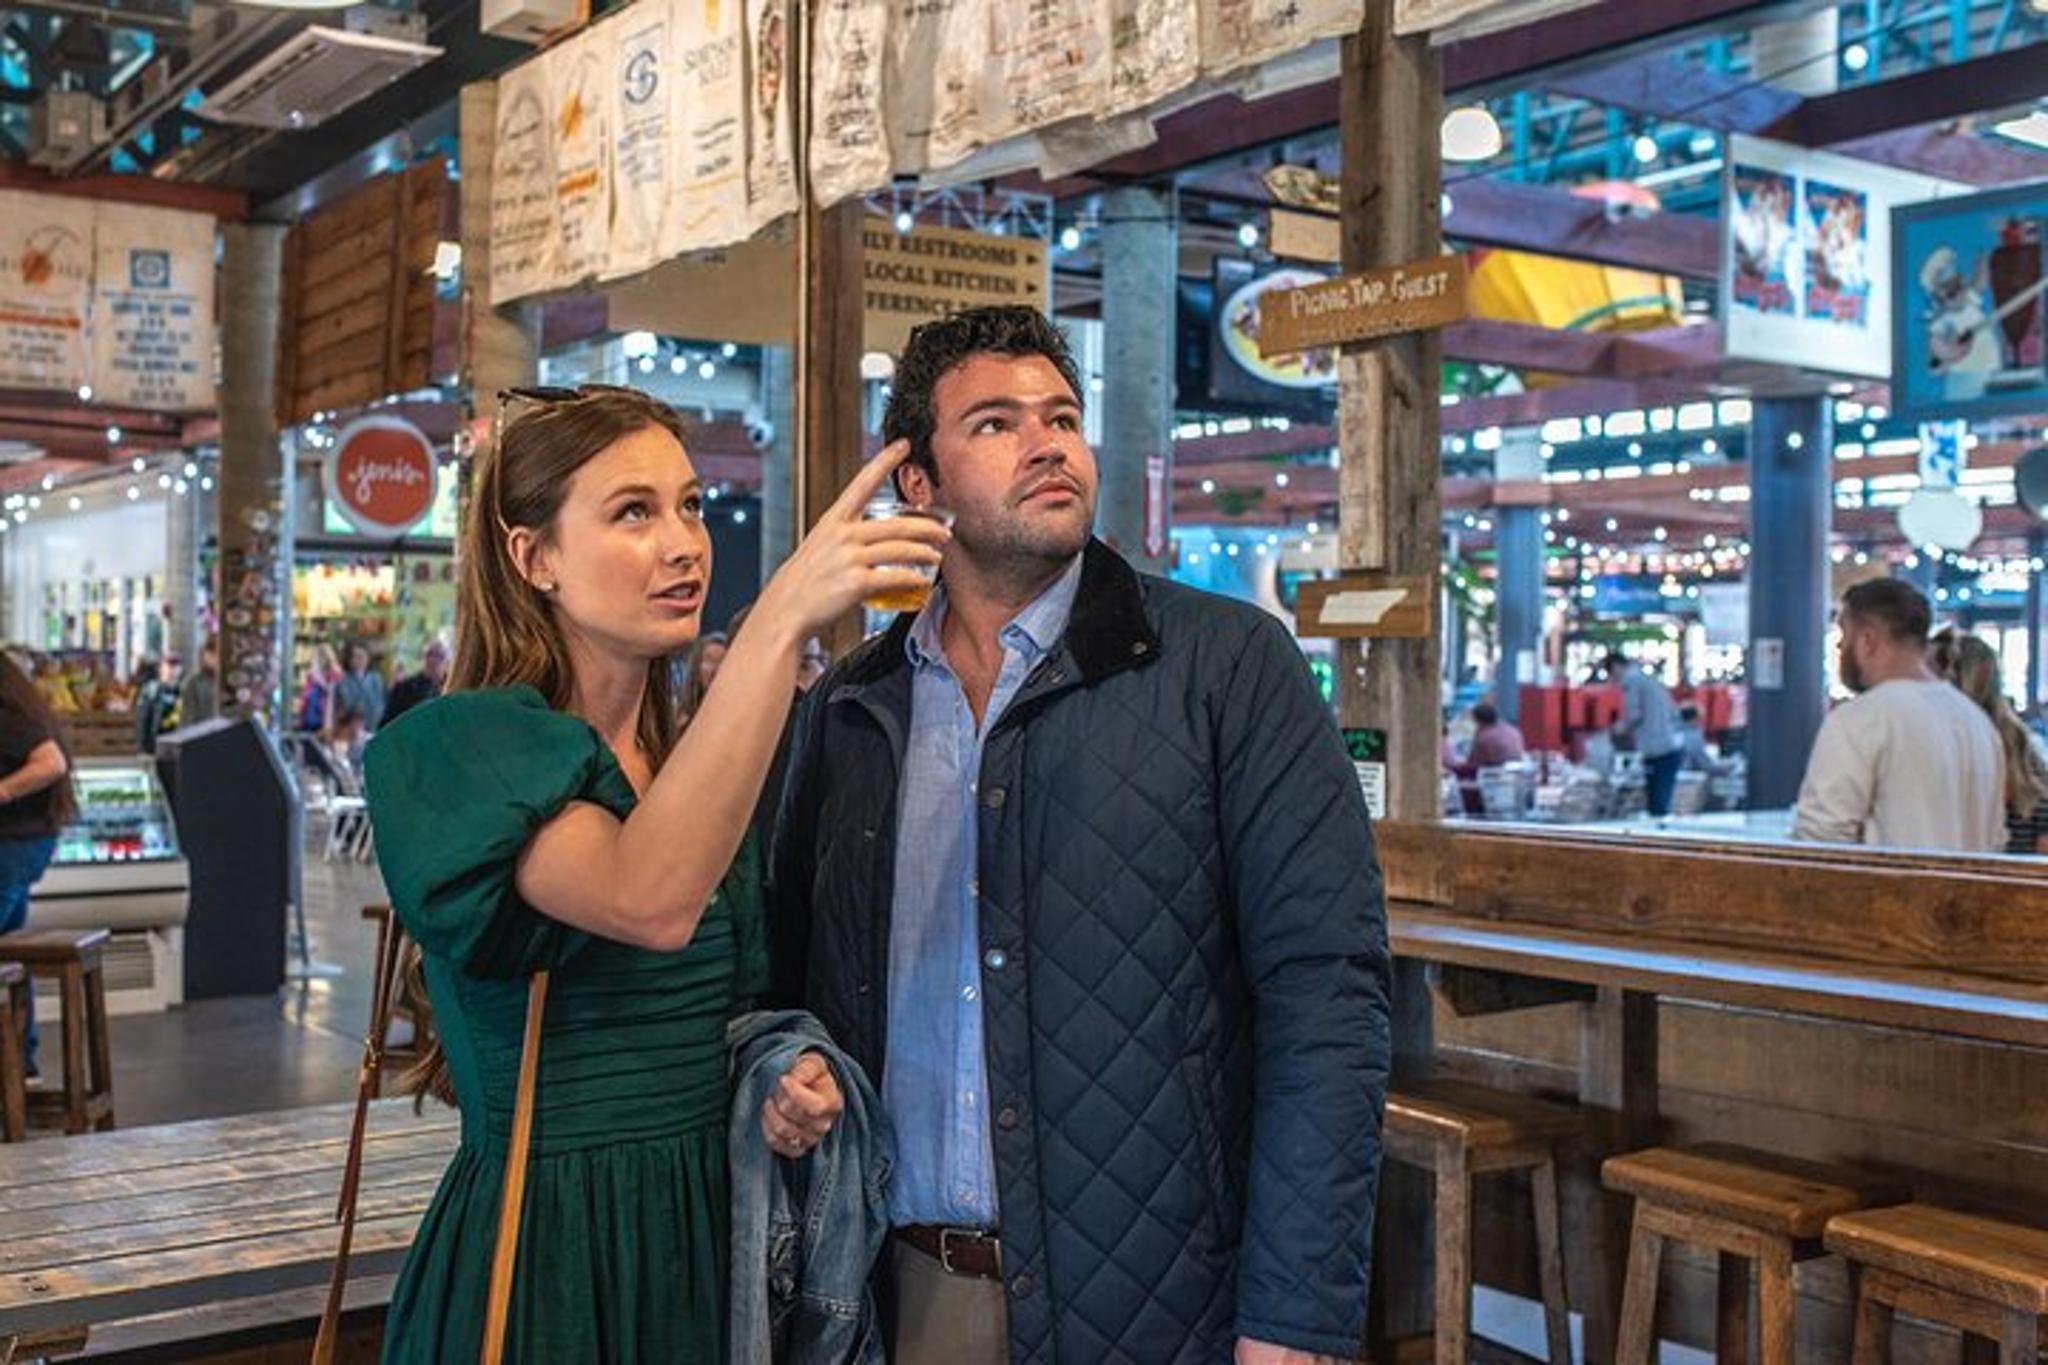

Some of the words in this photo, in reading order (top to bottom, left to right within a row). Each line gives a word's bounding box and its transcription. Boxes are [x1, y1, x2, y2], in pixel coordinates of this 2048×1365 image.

[901, 236, 1017, 265] RESTROOMS
[864, 261, 926, 285] LOCAL
[933, 269, 1017, 294] KITCHEN
[1391, 271, 1449, 301] GUEST
